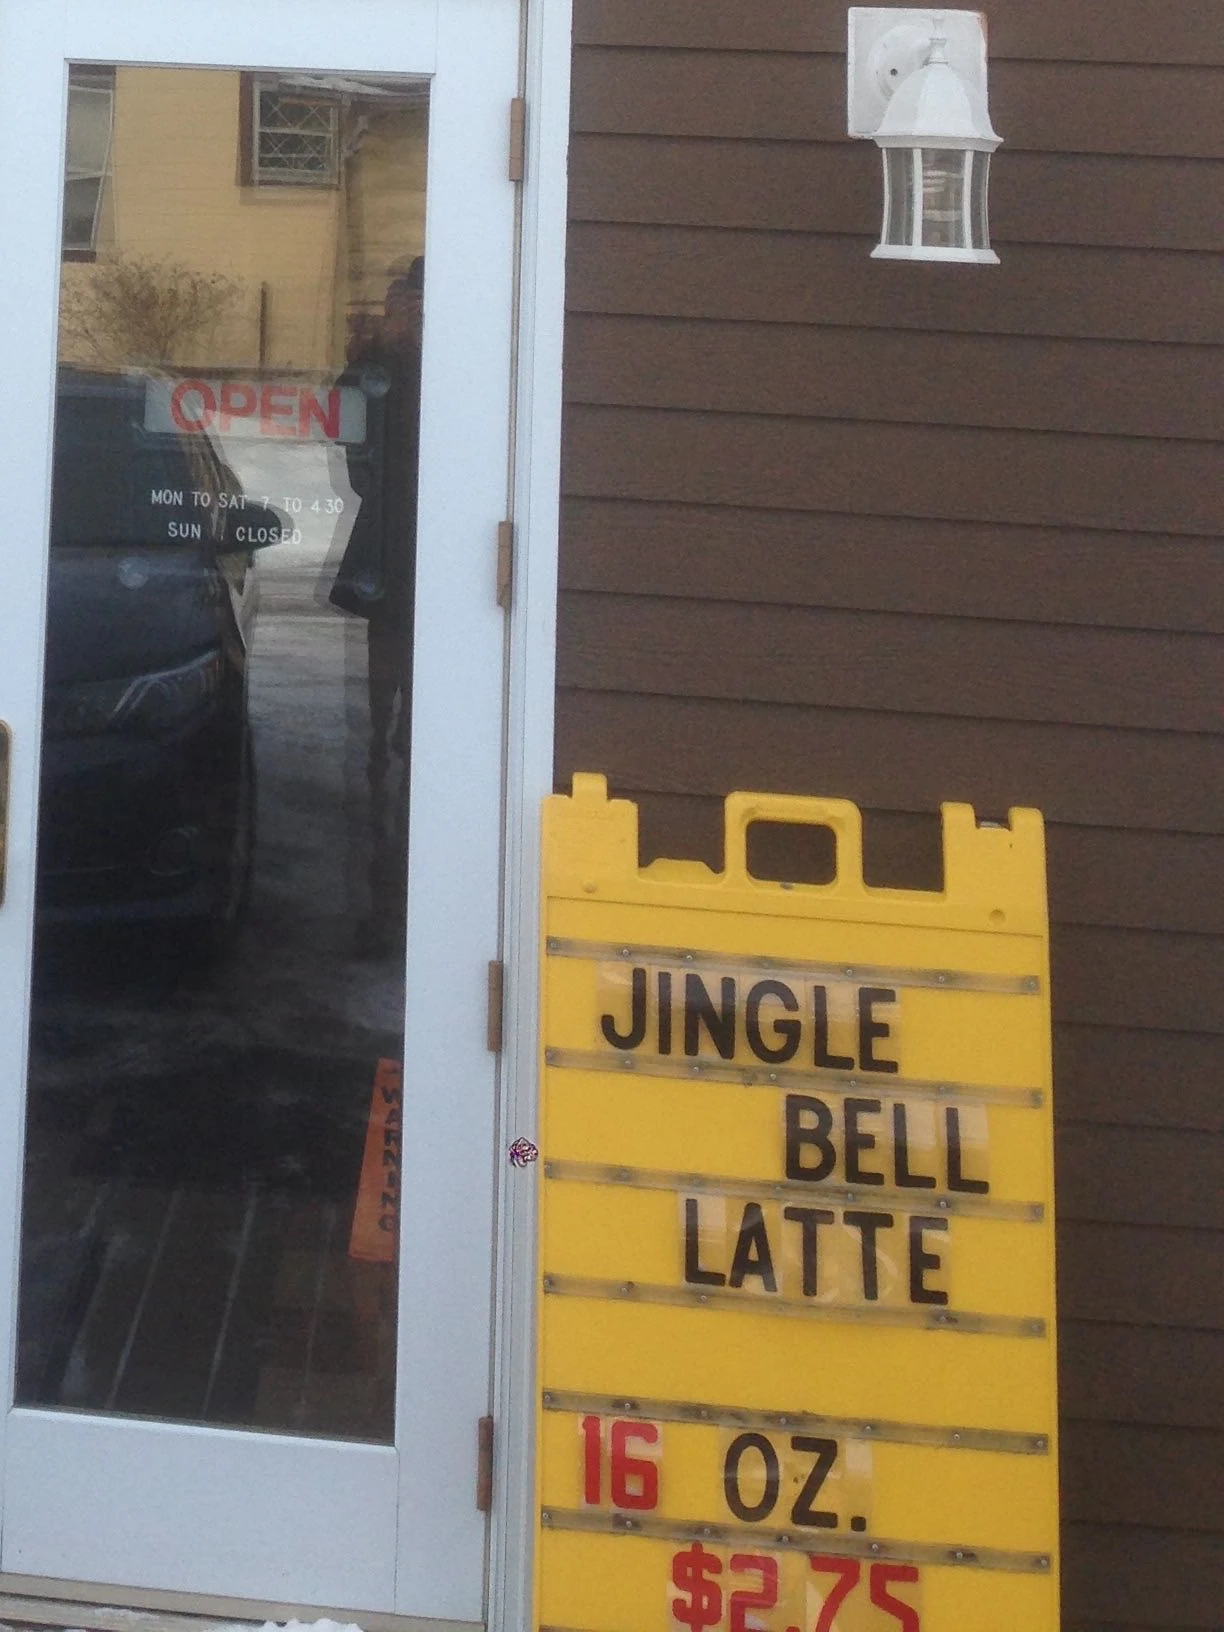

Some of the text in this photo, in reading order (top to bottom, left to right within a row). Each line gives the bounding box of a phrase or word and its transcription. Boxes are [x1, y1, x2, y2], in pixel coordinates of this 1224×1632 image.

[170, 378, 341, 439] OPEN
[151, 489, 183, 506] MON
[192, 491, 210, 508] TO
[218, 493, 247, 510] SAT
[283, 497, 302, 513] TO
[168, 521, 302, 545] SUN CLOSED
[601, 966, 899, 1074] JINGLE
[785, 1094, 989, 1195] BELL
[684, 1199, 949, 1306] LATTE
[581, 1415, 867, 1532] 16 OZ.
